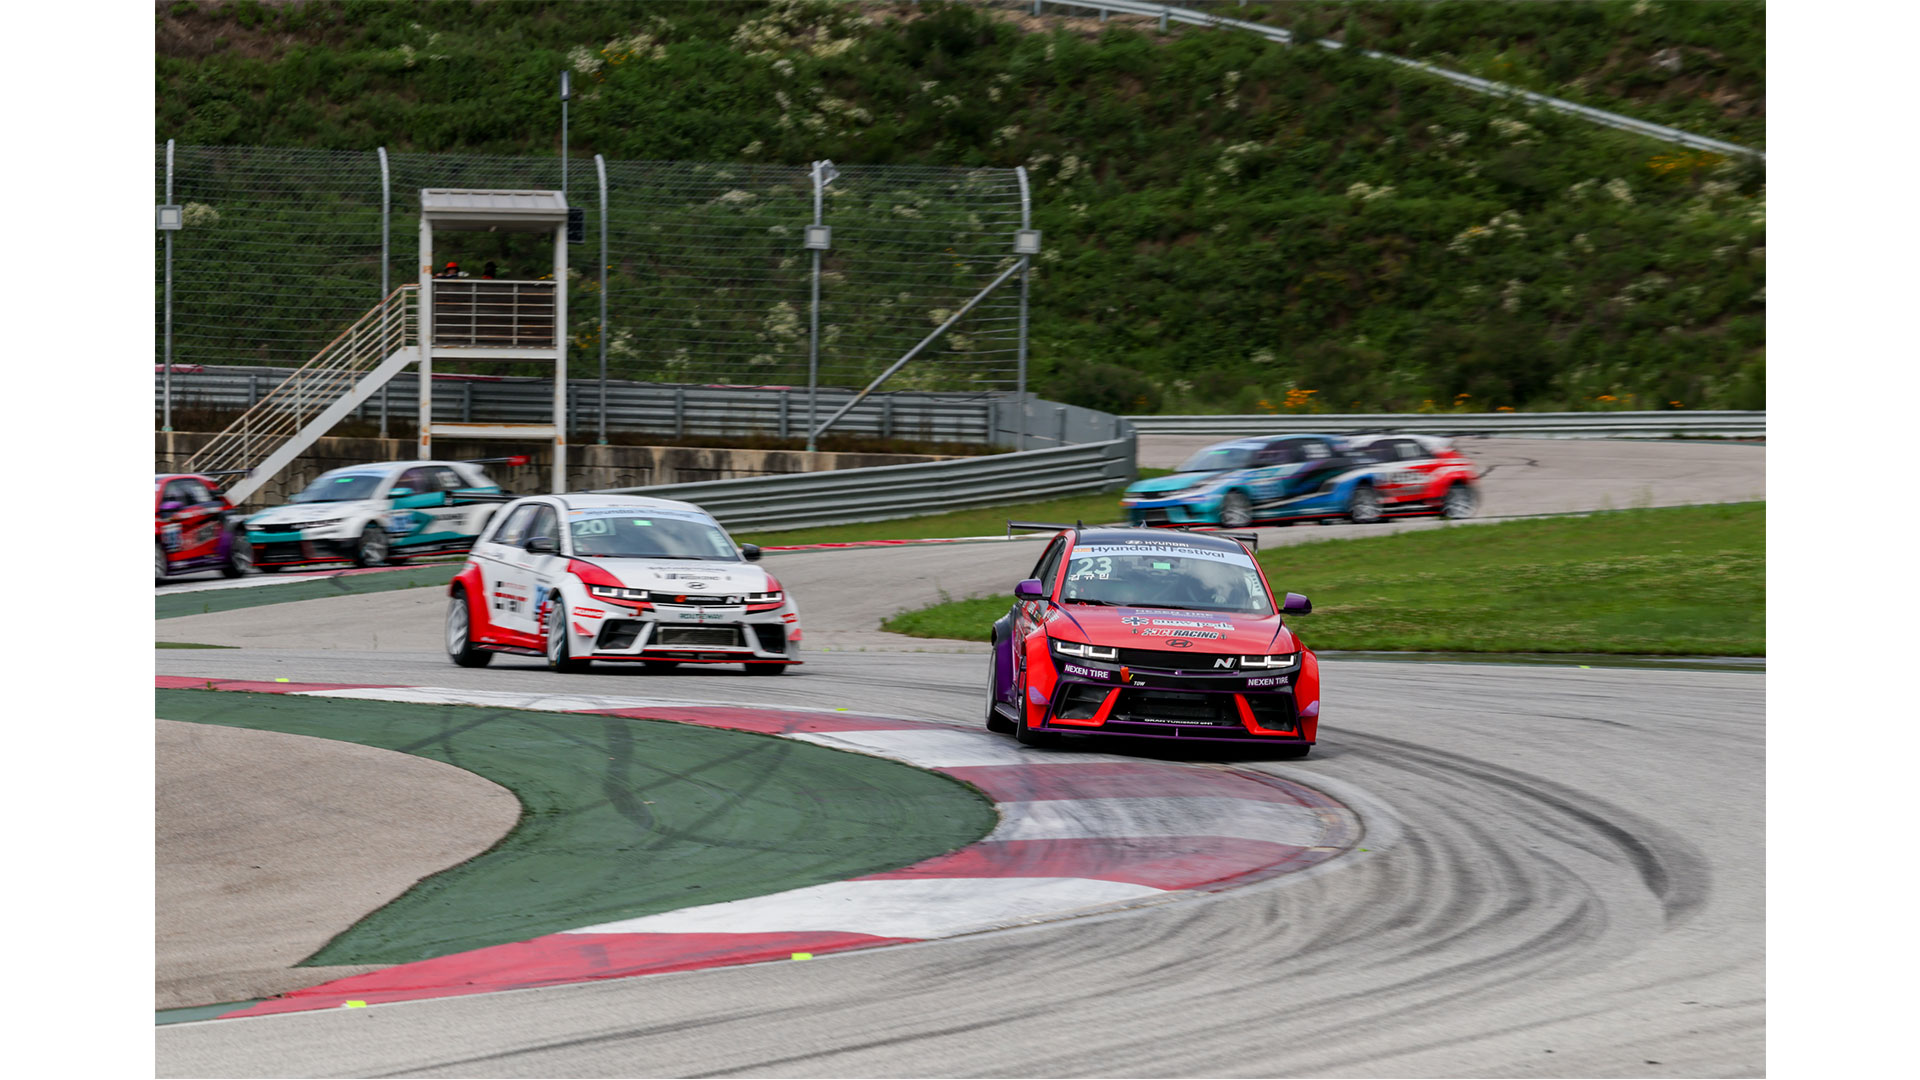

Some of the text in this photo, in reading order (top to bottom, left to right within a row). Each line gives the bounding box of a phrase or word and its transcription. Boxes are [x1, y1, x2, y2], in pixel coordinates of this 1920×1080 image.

[575, 519, 607, 535] 20
[1091, 545, 1225, 559] Hyundai N Festival
[1077, 557, 1112, 575] 23
[725, 596, 743, 604] N
[1213, 657, 1237, 668] N
[1064, 664, 1109, 679] NEXEN TIRE
[1247, 676, 1288, 686] NEXEN TIRE
